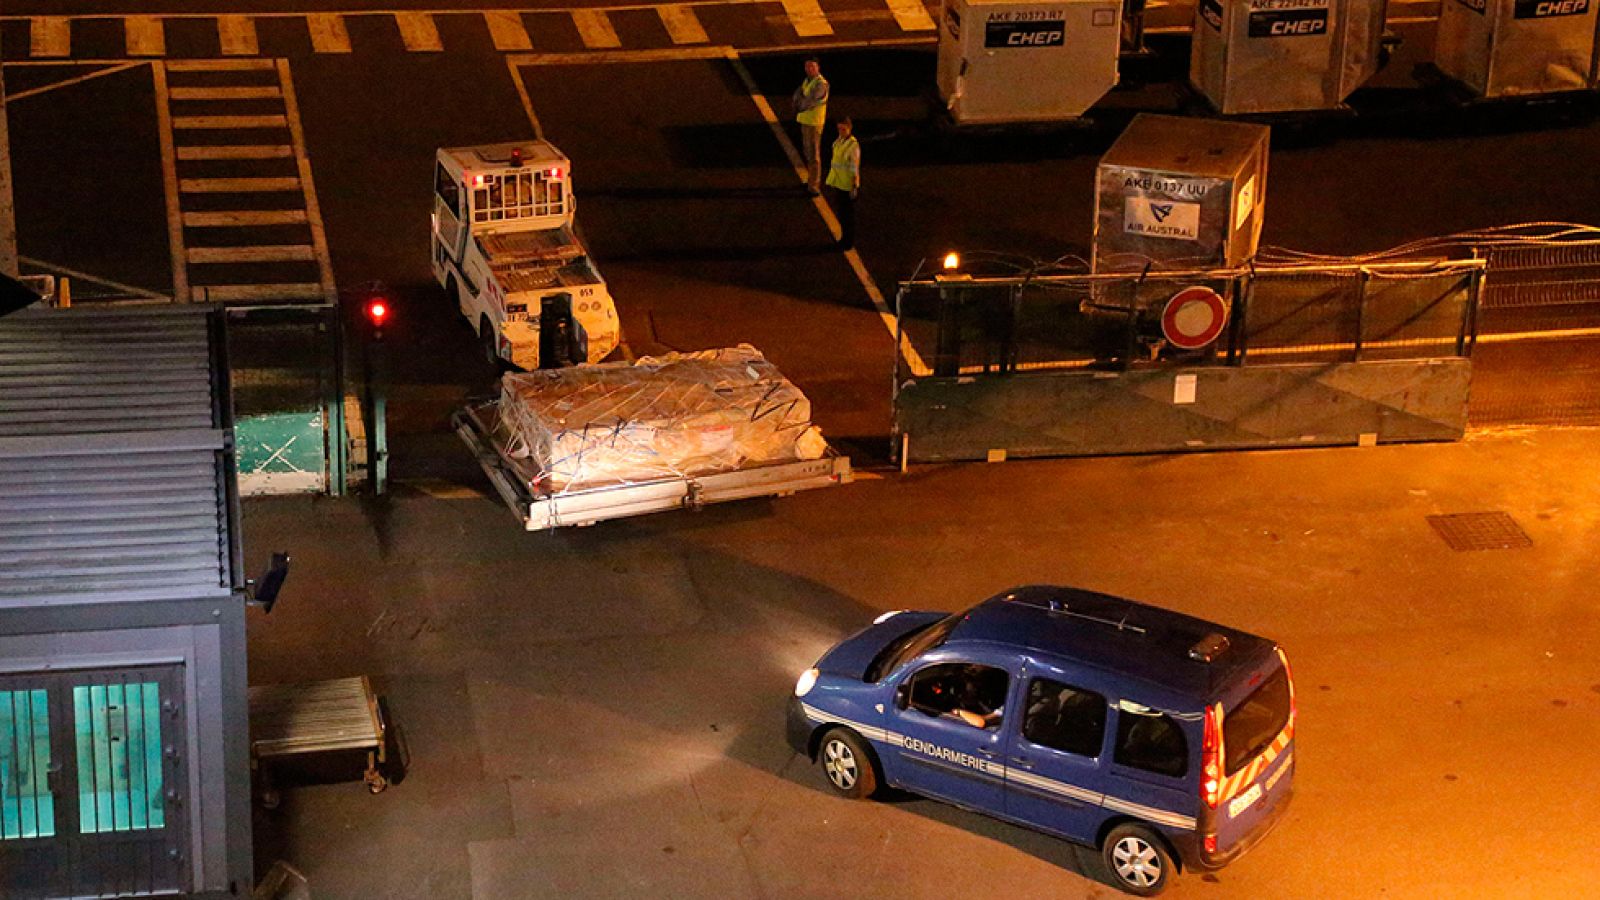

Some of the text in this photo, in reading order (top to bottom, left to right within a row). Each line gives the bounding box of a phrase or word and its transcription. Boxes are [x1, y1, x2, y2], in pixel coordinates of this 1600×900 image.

[1535, 0, 1586, 16] CHEP
[1270, 19, 1325, 35] CHEP
[1007, 31, 1062, 45] CHEP
[1124, 177, 1152, 189] AKE
[1187, 185, 1206, 196] UU
[1127, 223, 1194, 238] AIR AUSTRAL
[904, 736, 989, 773] GENDARMERIE
